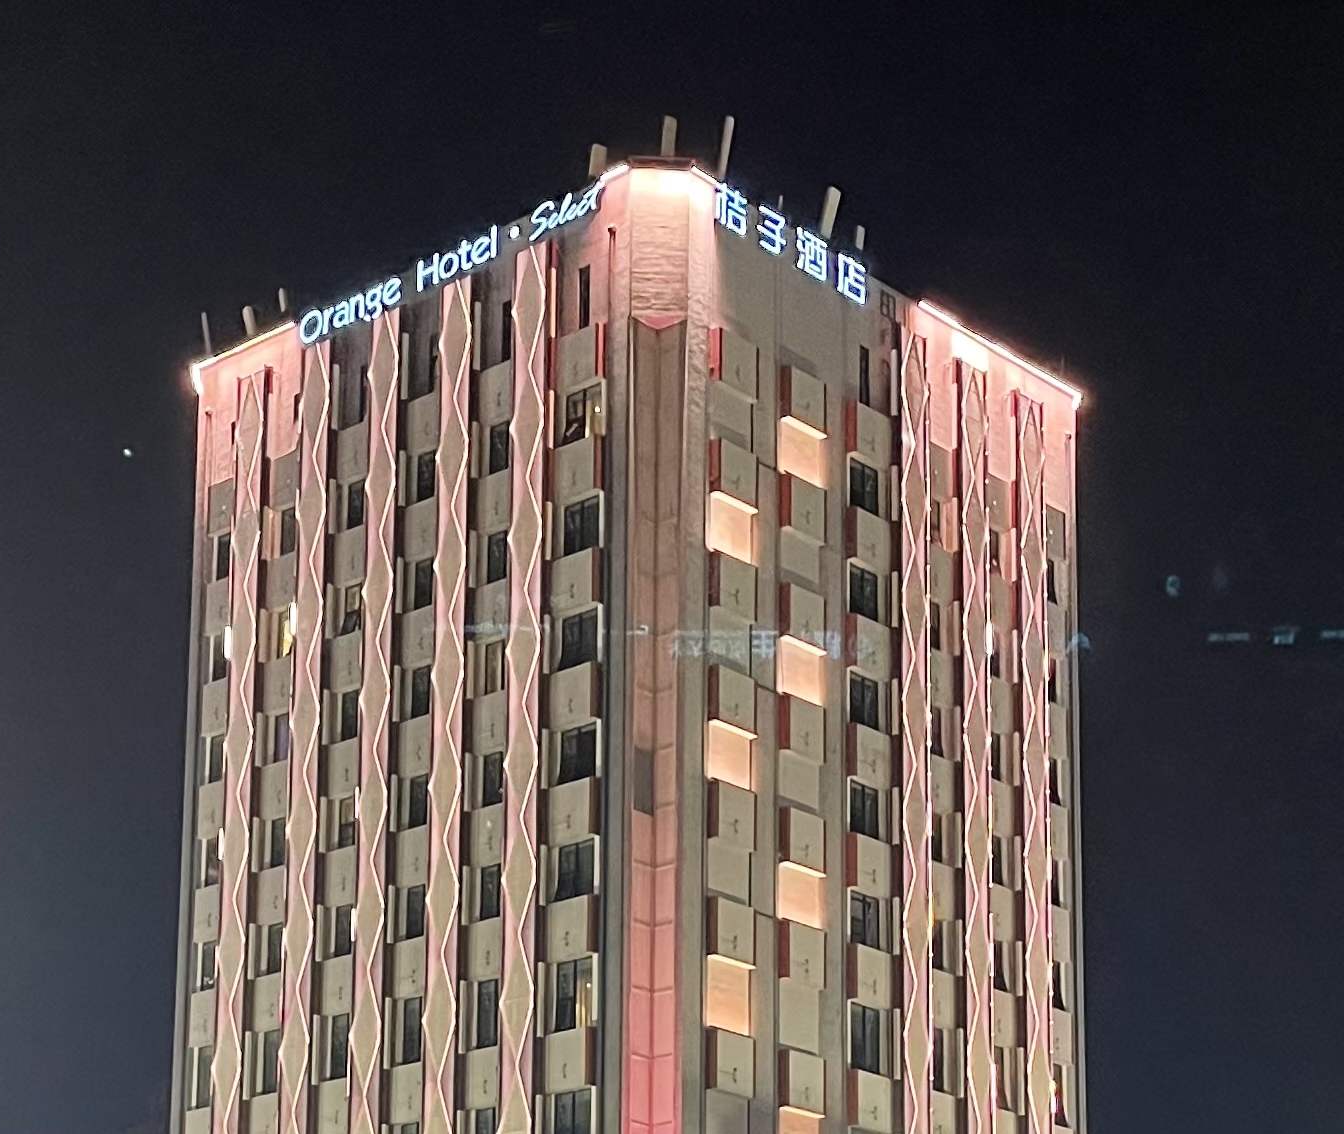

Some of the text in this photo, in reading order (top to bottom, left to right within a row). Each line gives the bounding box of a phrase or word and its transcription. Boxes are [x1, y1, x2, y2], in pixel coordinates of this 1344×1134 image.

[299, 177, 603, 344] Orange Hotel Select
[714, 179, 867, 305] 桔子酒店
